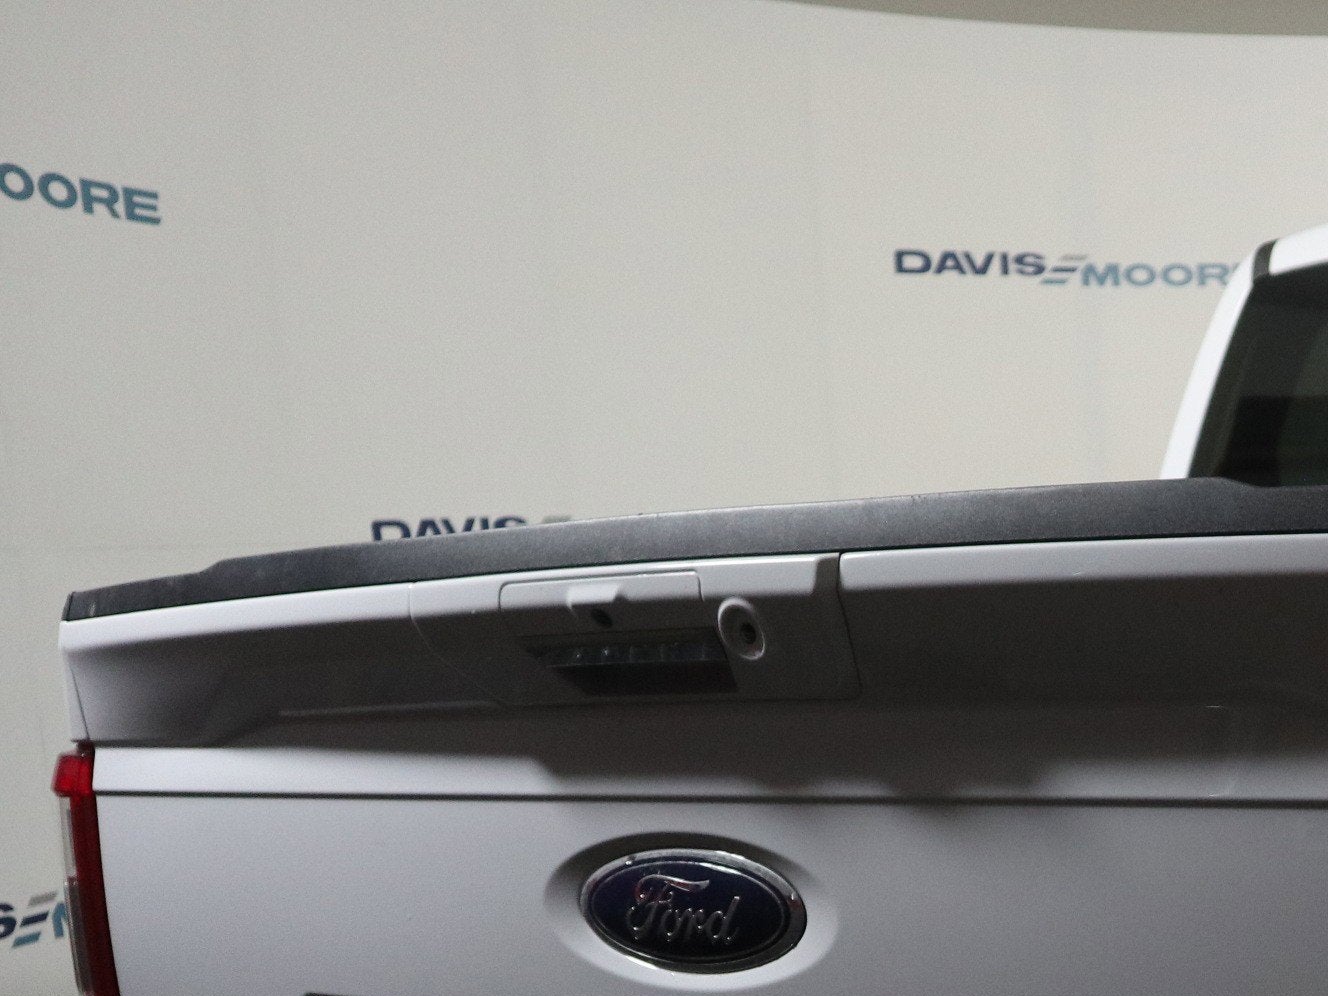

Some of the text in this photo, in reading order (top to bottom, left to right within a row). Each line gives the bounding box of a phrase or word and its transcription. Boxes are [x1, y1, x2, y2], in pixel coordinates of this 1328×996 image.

[895, 250, 1240, 287] DAVIS MOOR
[625, 873, 741, 944] Ford
